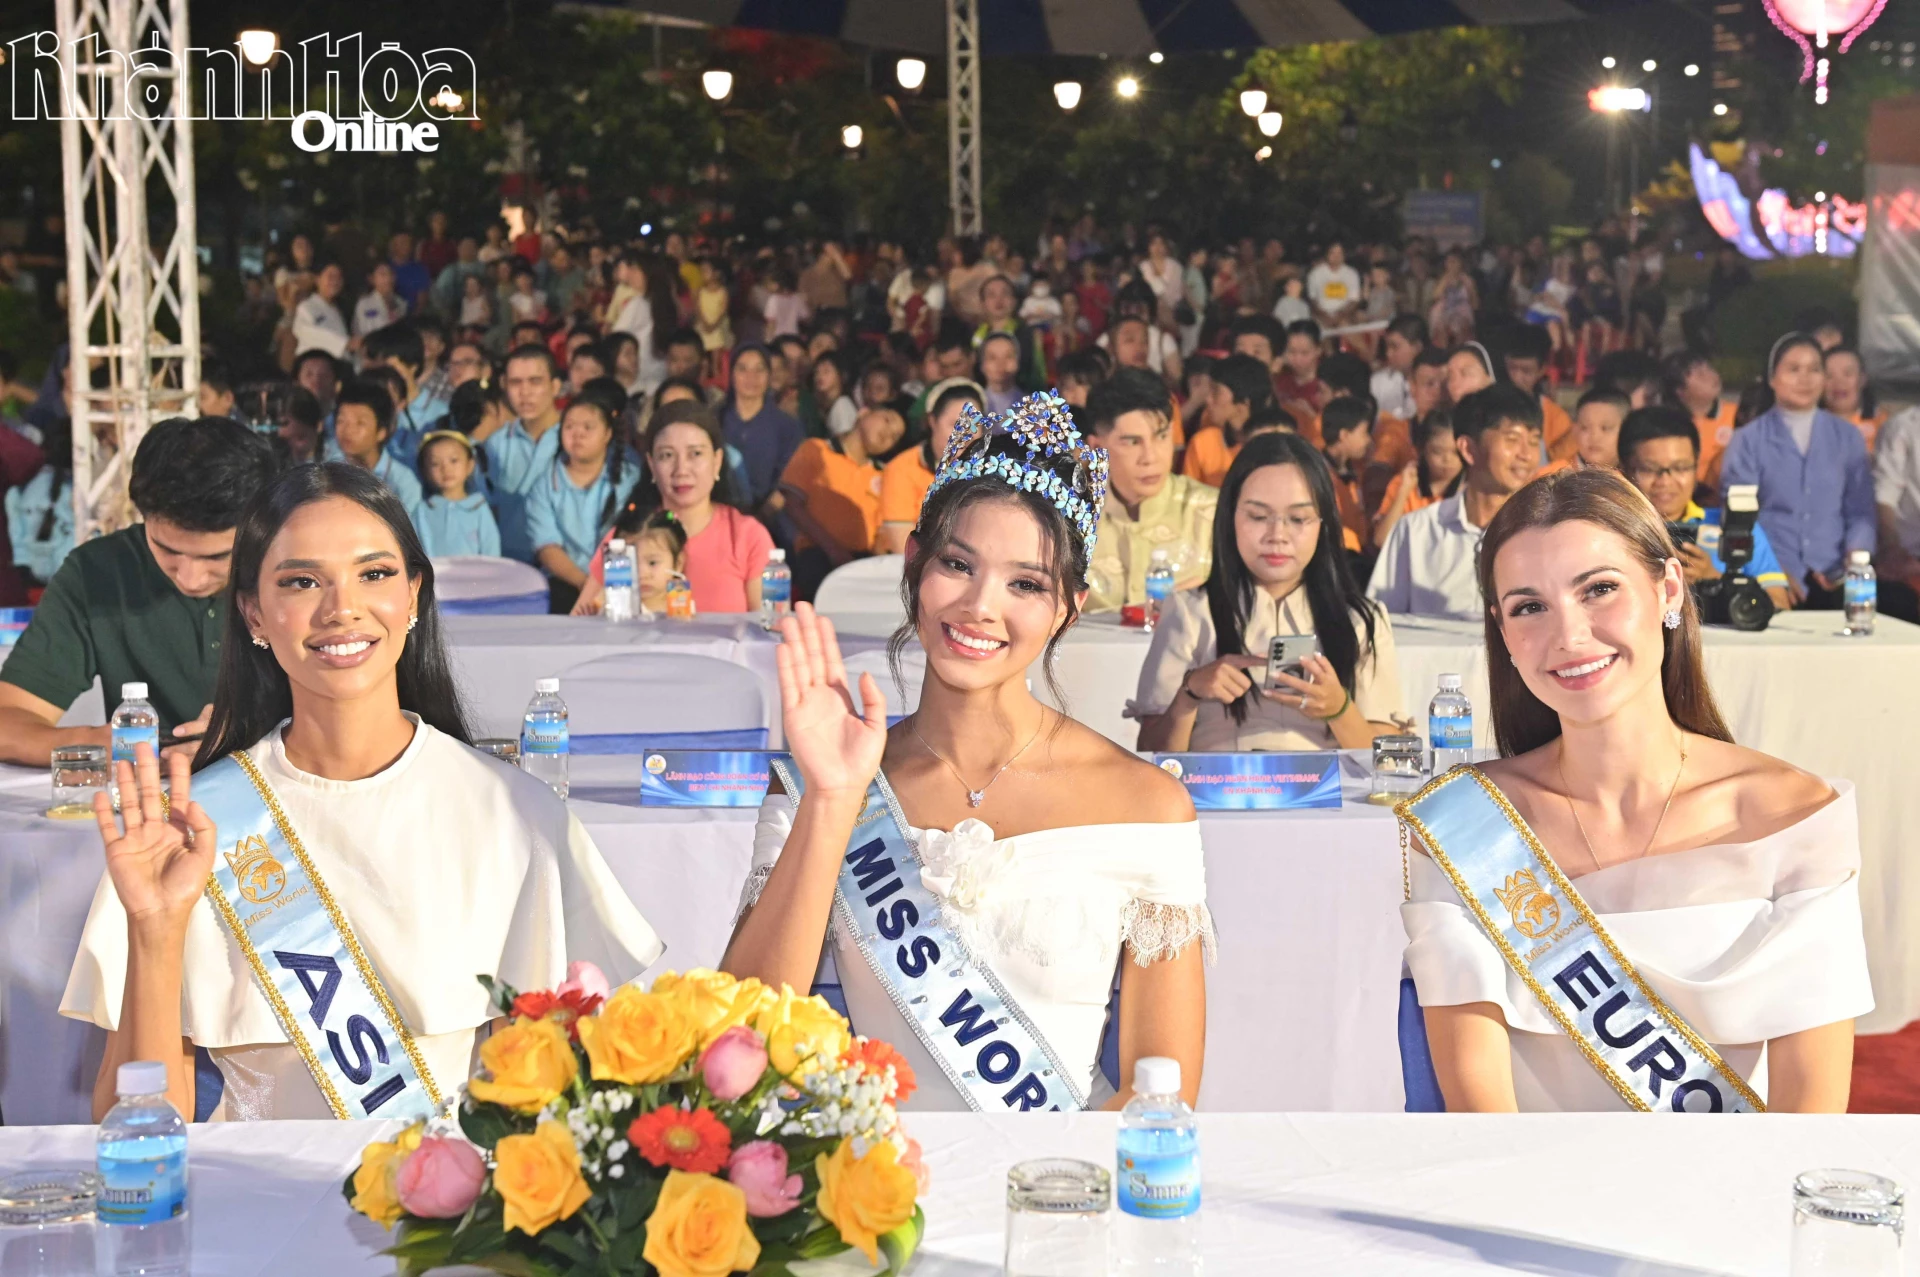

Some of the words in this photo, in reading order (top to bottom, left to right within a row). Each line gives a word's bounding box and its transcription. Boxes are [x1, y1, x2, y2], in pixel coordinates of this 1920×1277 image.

[243, 907, 273, 928] Miss
[272, 884, 309, 909] World
[845, 837, 941, 978] MISS
[1524, 941, 1552, 963] Miss
[273, 950, 407, 1116] ASI
[938, 988, 1061, 1112] WOR
[1553, 950, 1741, 1113] EURO
